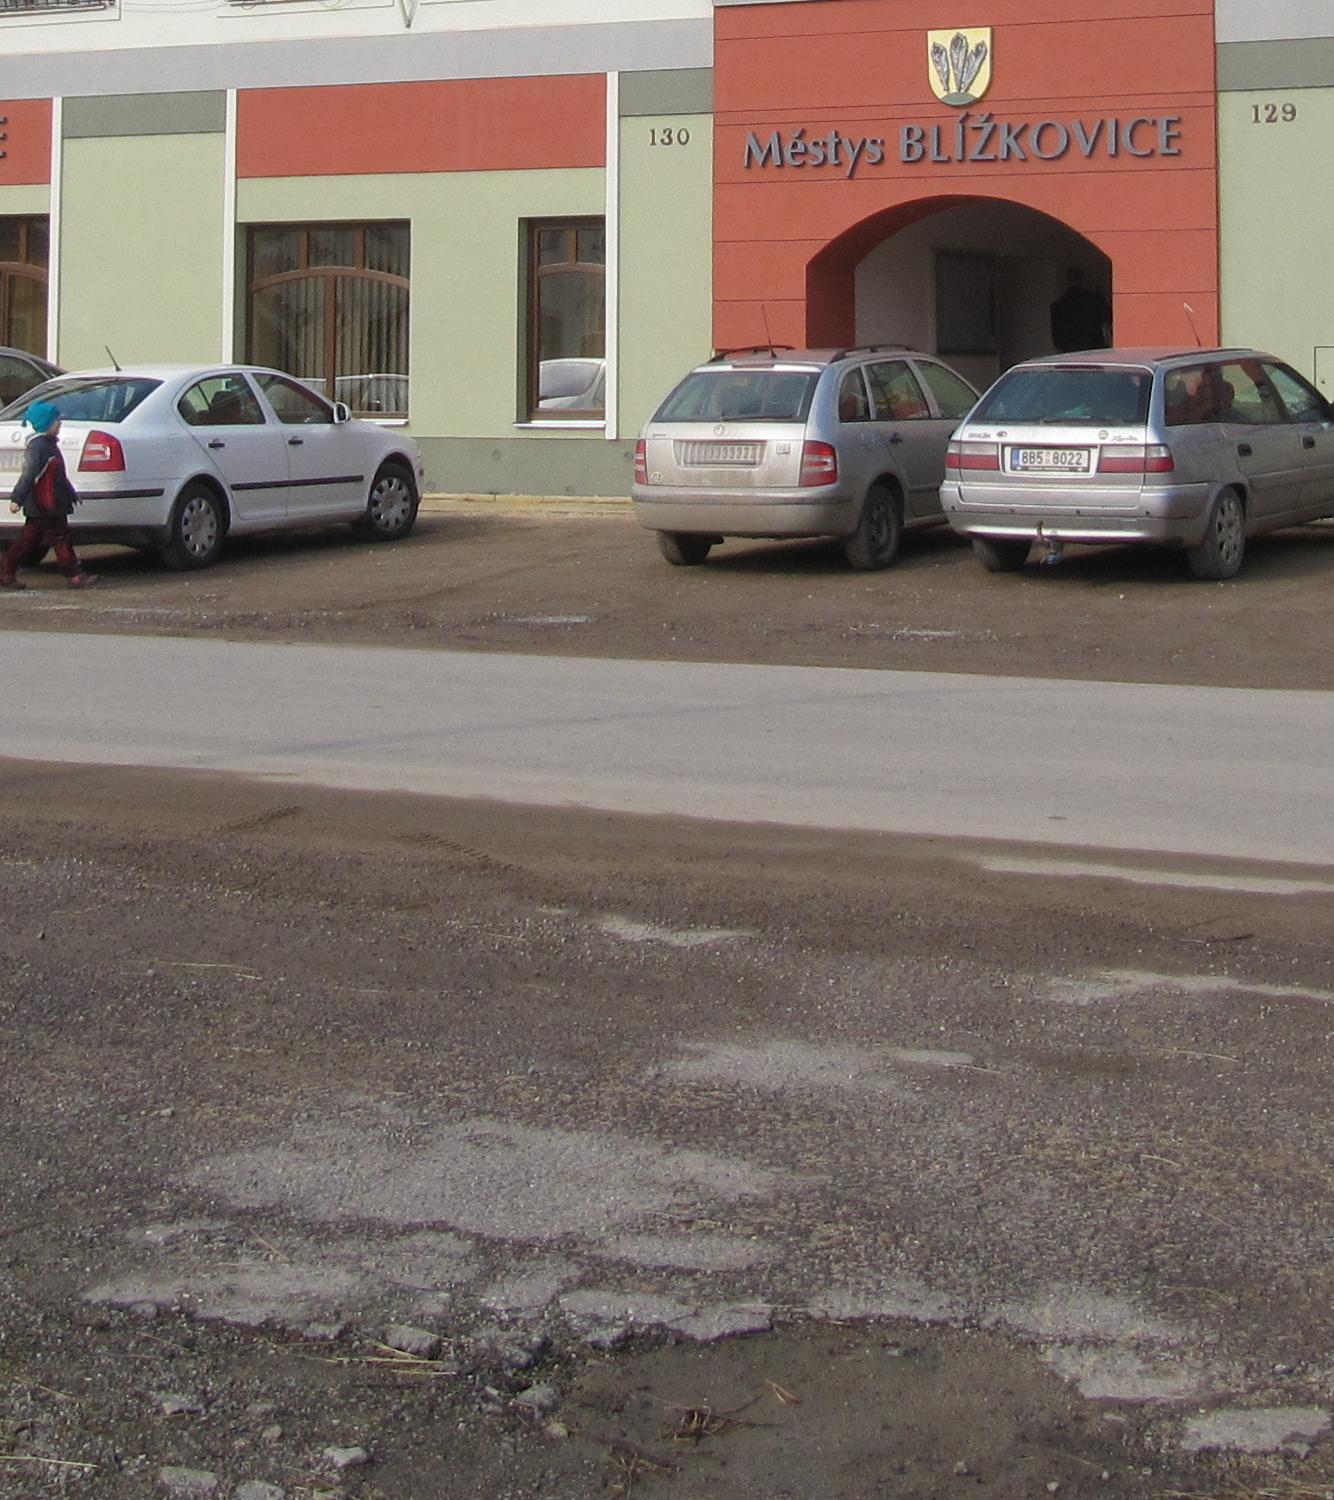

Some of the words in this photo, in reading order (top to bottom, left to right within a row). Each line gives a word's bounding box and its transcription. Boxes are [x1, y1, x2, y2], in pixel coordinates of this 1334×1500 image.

[1252, 103, 1297, 124] 129
[649, 127, 690, 146] 130
[743, 127, 885, 179] Městys
[899, 111, 1182, 163] BLÍŽKOVICE
[1021, 451, 1043, 465] 8B5
[1052, 452, 1082, 466] 8022
